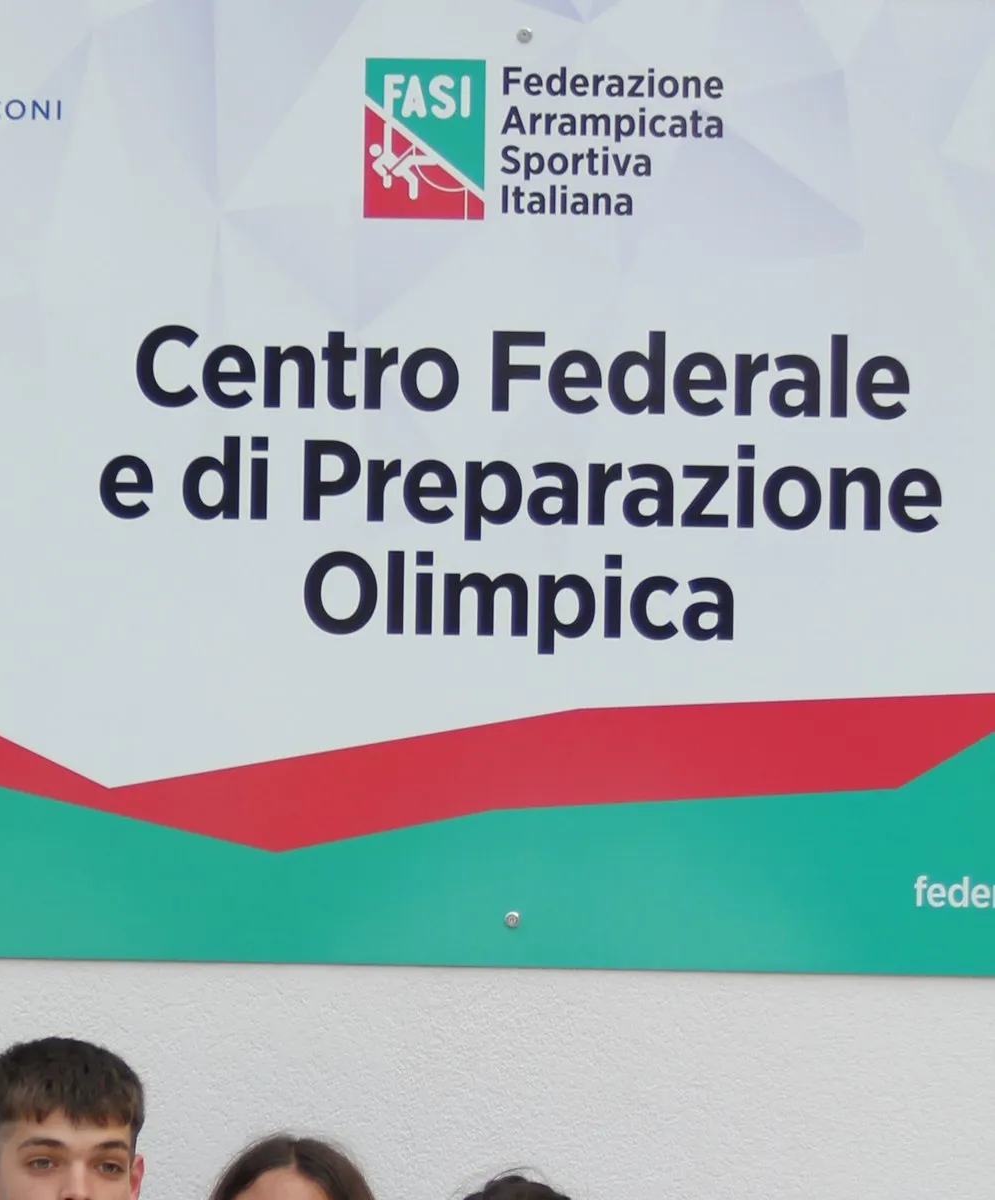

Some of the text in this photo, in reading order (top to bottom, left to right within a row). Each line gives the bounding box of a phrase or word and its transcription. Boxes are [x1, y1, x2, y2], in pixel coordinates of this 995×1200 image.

[383, 73, 471, 120] FASI
[503, 67, 724, 100] Federazione
[501, 106, 725, 141] Arrampicata
[501, 145, 652, 178] Sportiva
[502, 185, 634, 217] Italiana
[136, 324, 911, 422] Centro Federale
[100, 436, 943, 543] e di Preparazione
[304, 550, 736, 656] Olimpica
